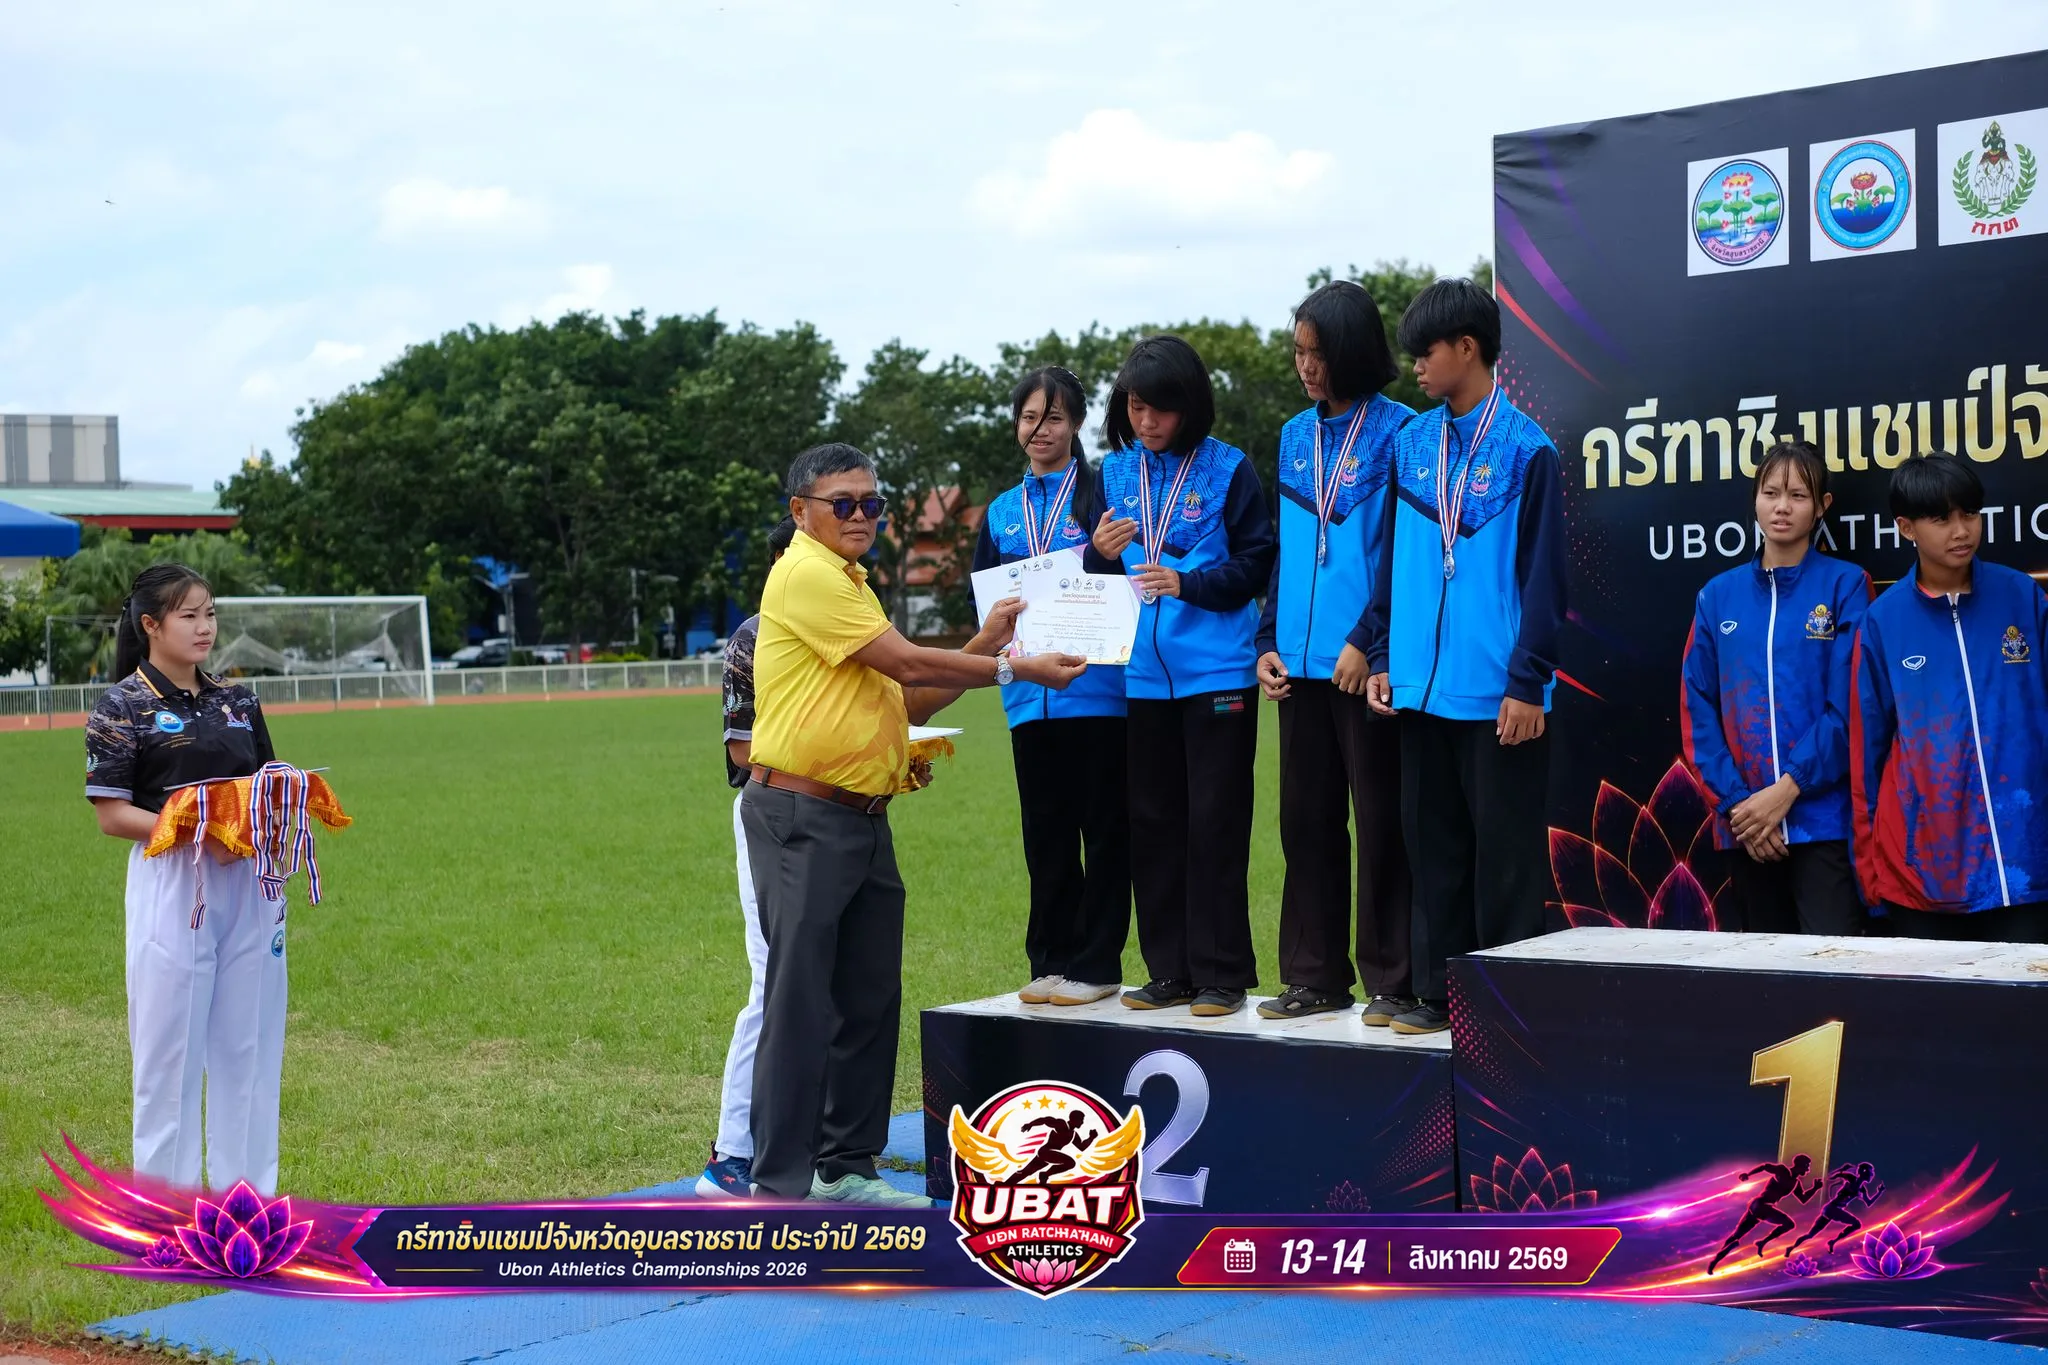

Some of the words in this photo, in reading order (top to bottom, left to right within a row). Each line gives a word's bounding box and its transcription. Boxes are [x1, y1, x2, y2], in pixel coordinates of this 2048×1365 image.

[1971, 217, 2019, 236] กกท
[1814, 503, 2048, 552] ATHTIC
[1123, 1049, 1210, 1207] 2
